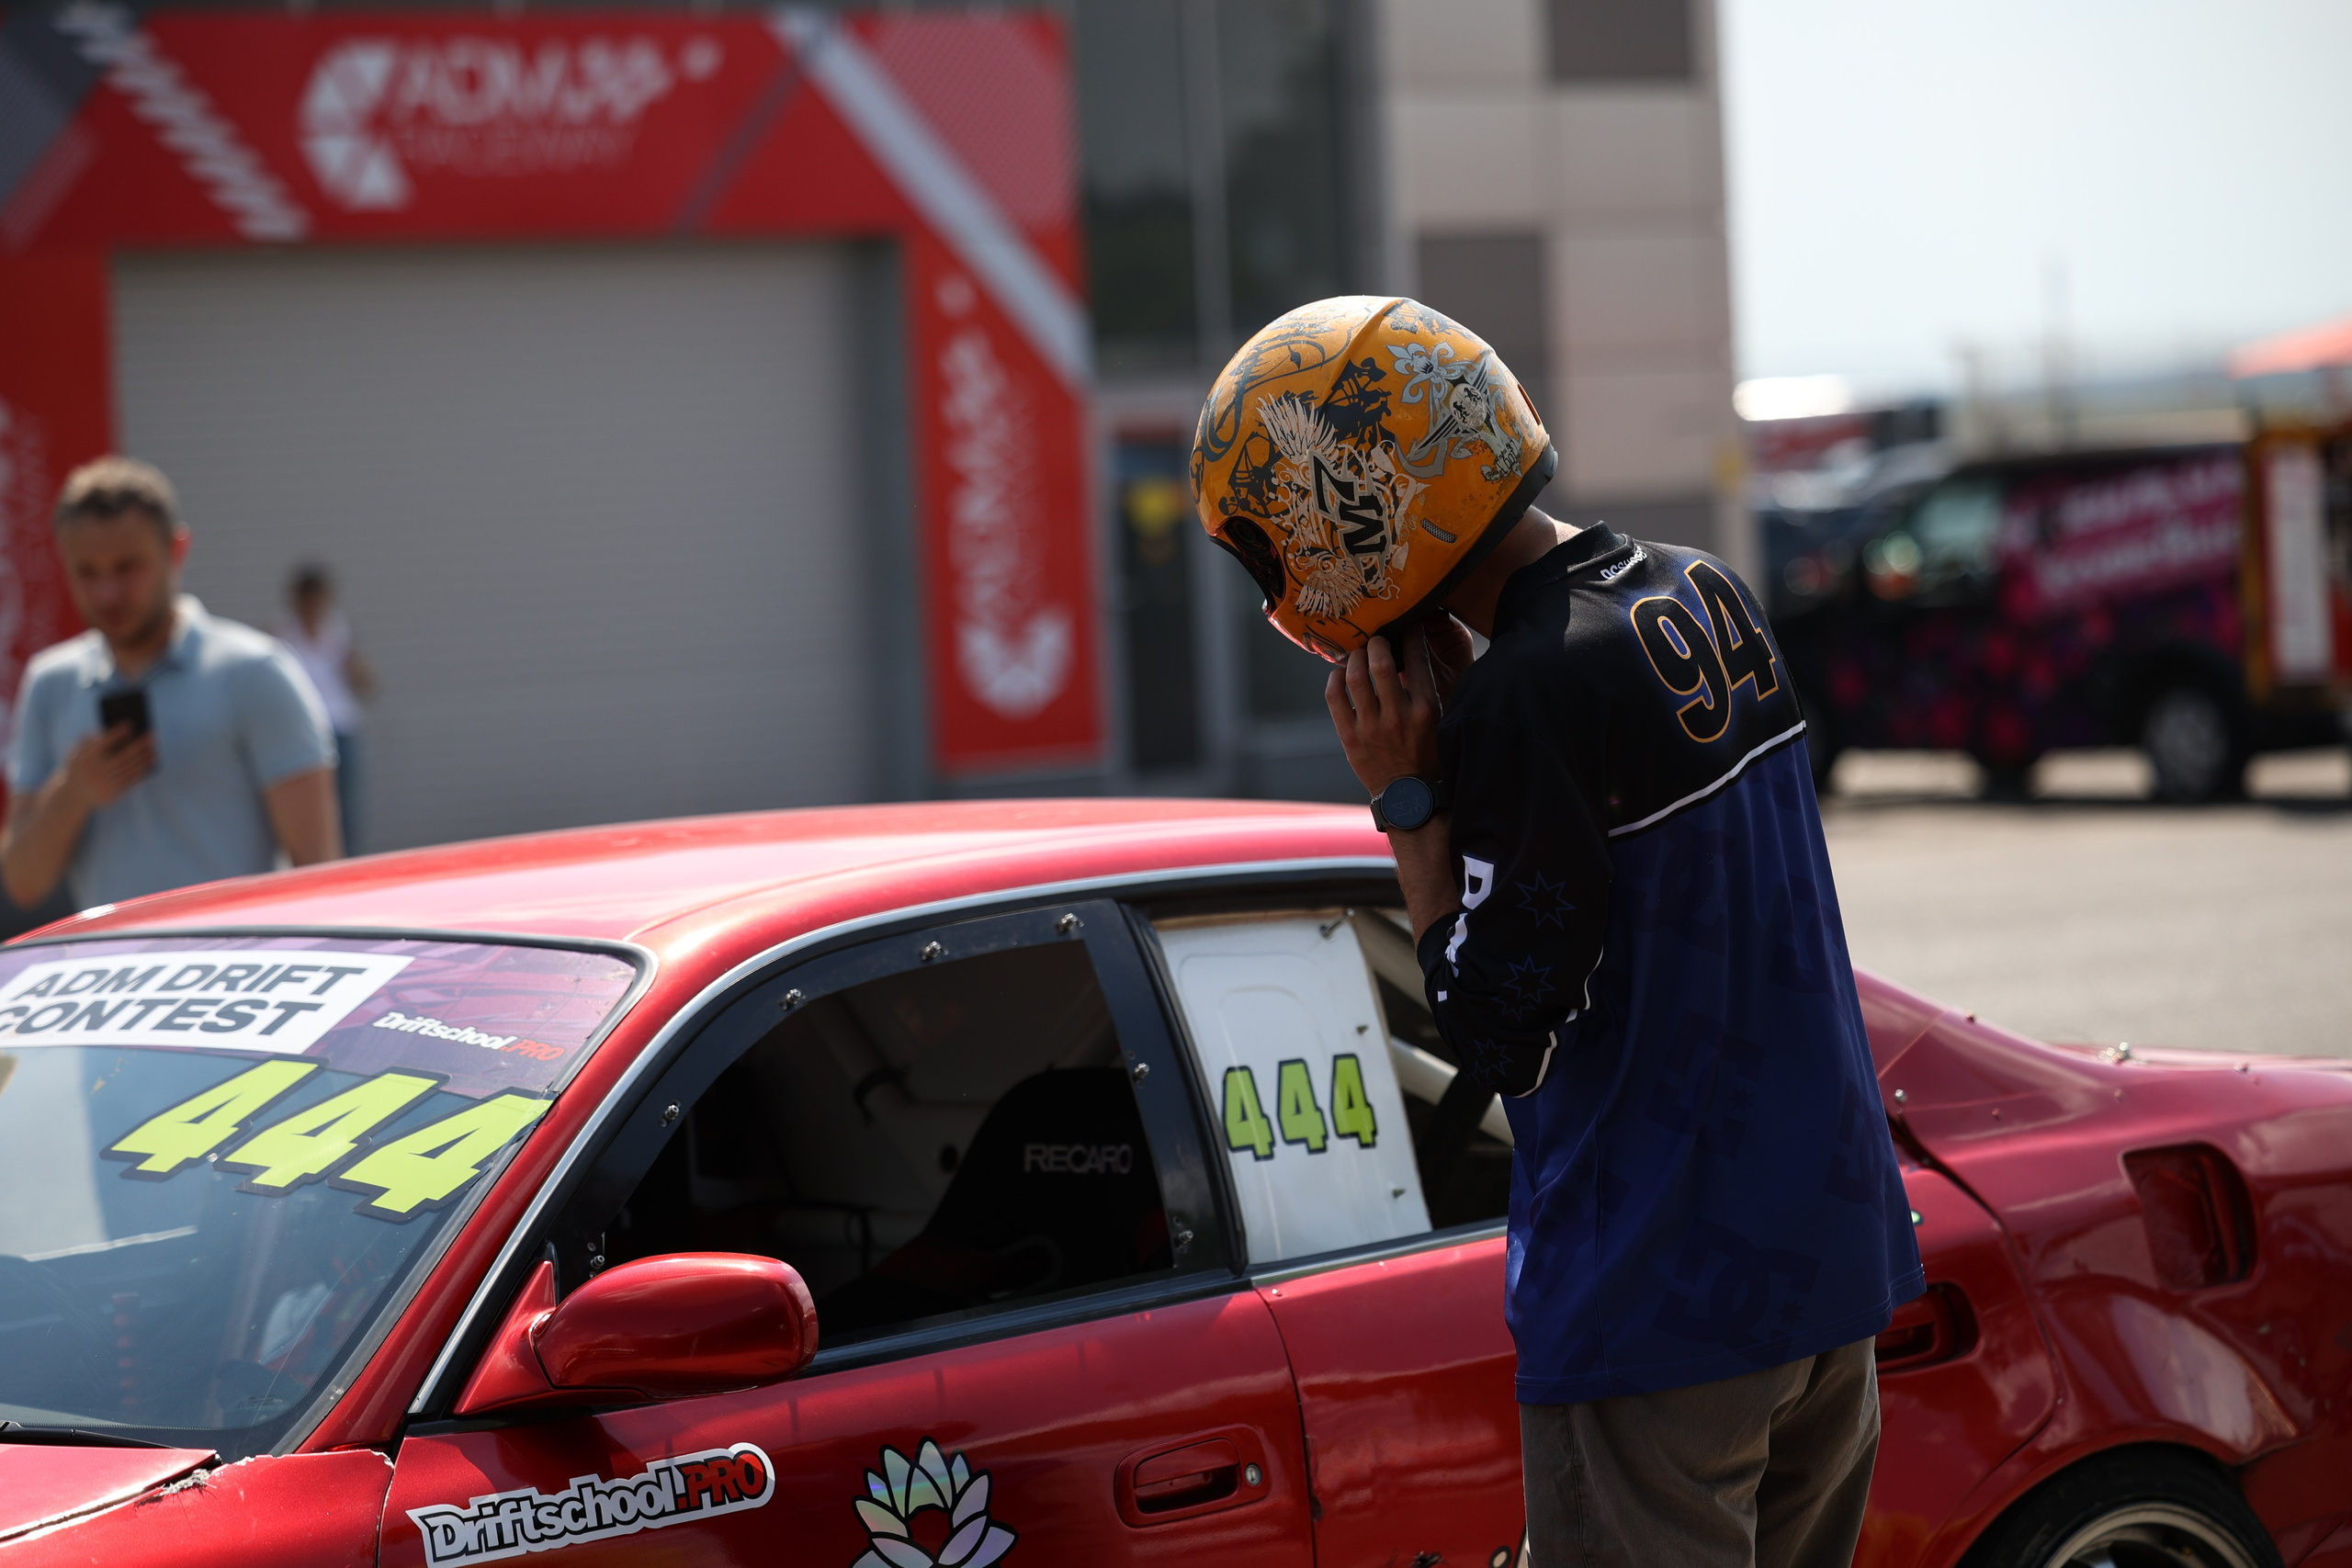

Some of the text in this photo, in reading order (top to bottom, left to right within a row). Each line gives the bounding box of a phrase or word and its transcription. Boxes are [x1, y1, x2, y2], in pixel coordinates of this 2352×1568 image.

[1630, 559, 1779, 742] 94
[7, 963, 368, 1001] ADM DRIFT
[103, 1056, 555, 1218] 444
[1023, 1144, 1132, 1174] RECARO
[1223, 1054, 1377, 1161] 444
